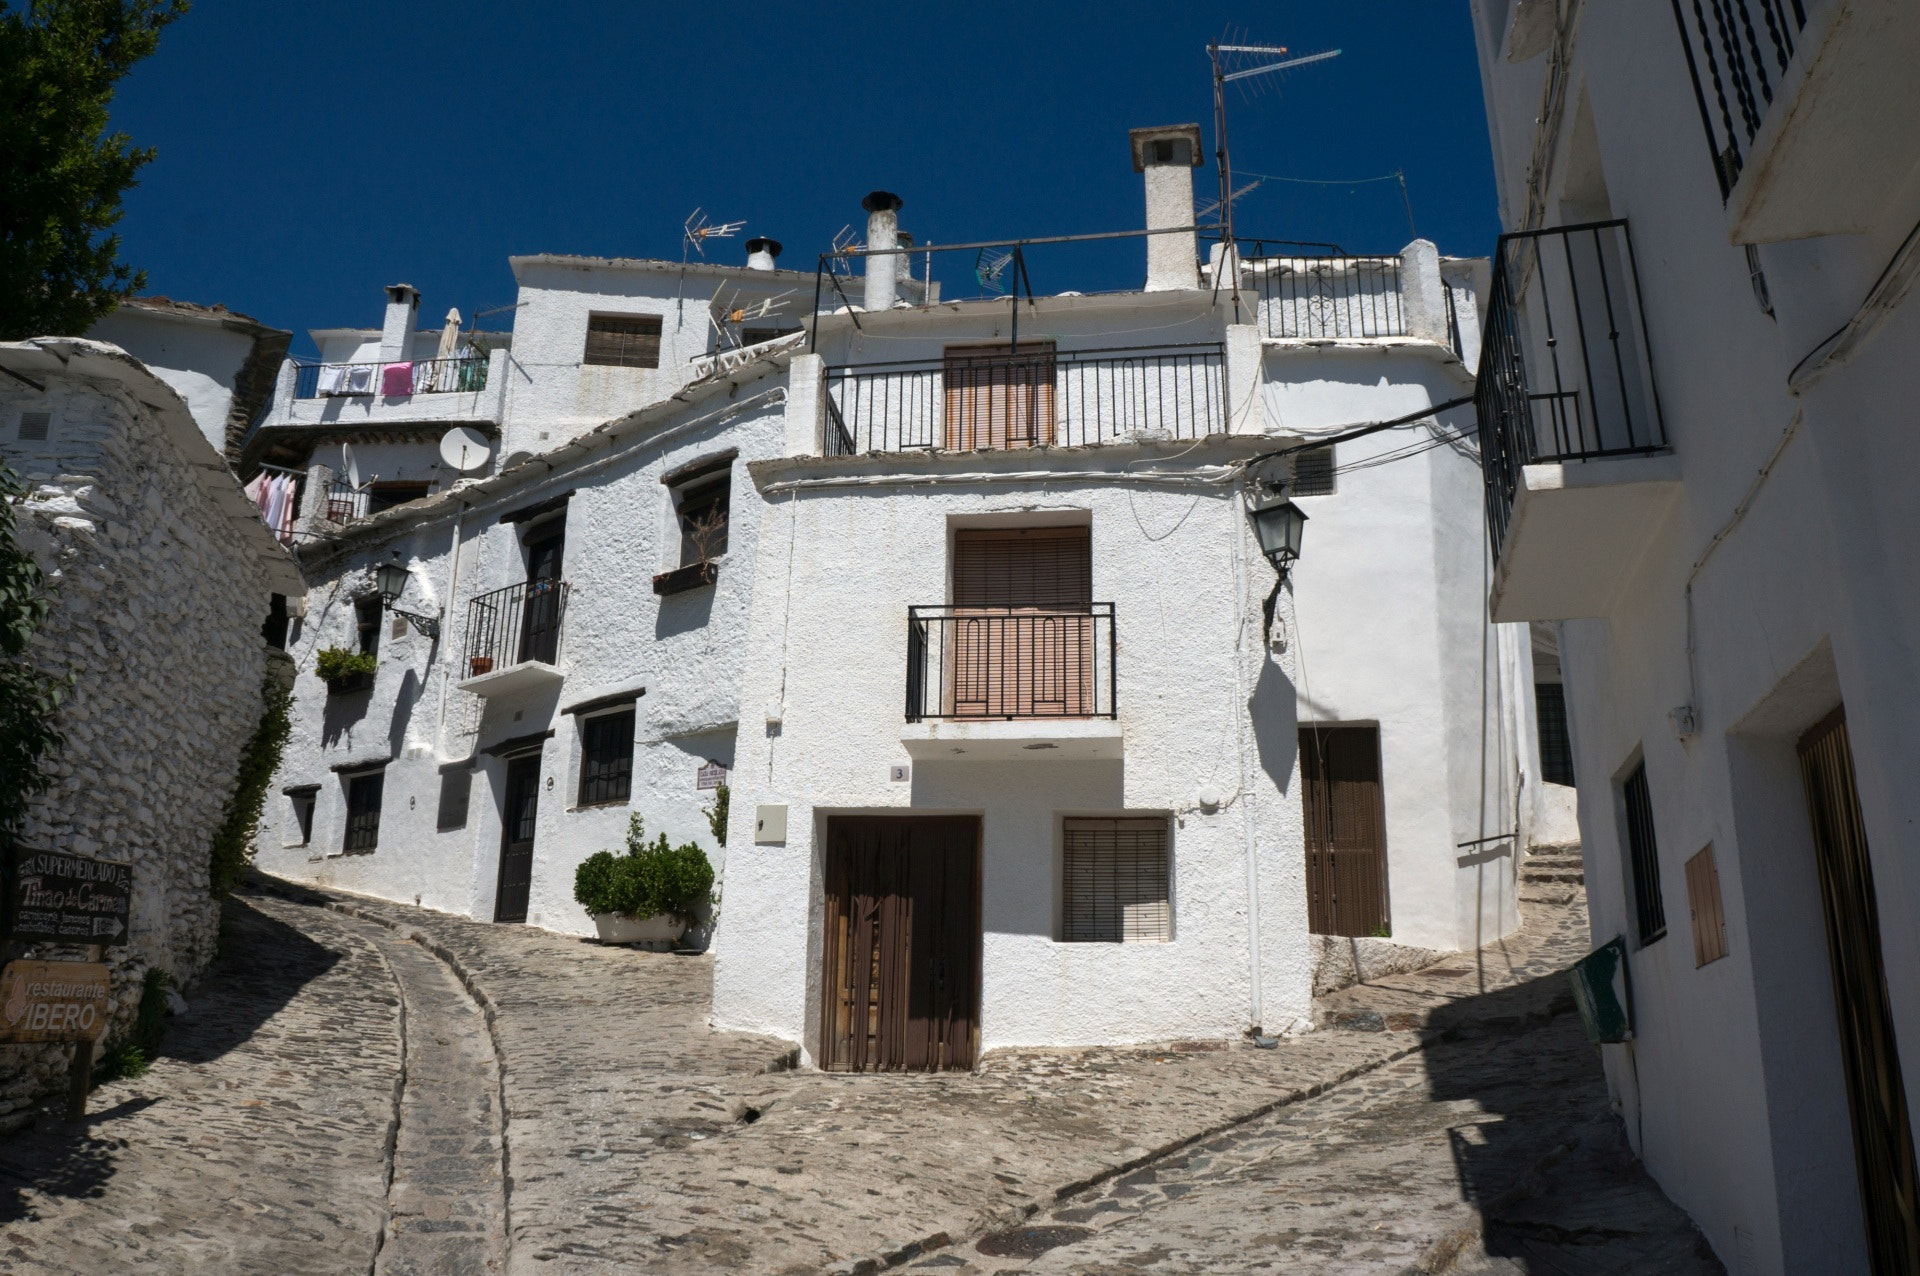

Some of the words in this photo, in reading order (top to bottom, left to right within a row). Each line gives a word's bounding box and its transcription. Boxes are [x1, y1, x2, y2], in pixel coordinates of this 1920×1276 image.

[896, 768, 903, 780] 3
[37, 854, 116, 883] SUPERMERCADO
[65, 888, 78, 907] de
[78, 882, 128, 914] Carmen
[25, 981, 106, 999] restaurante
[24, 1003, 96, 1031] IBERO
